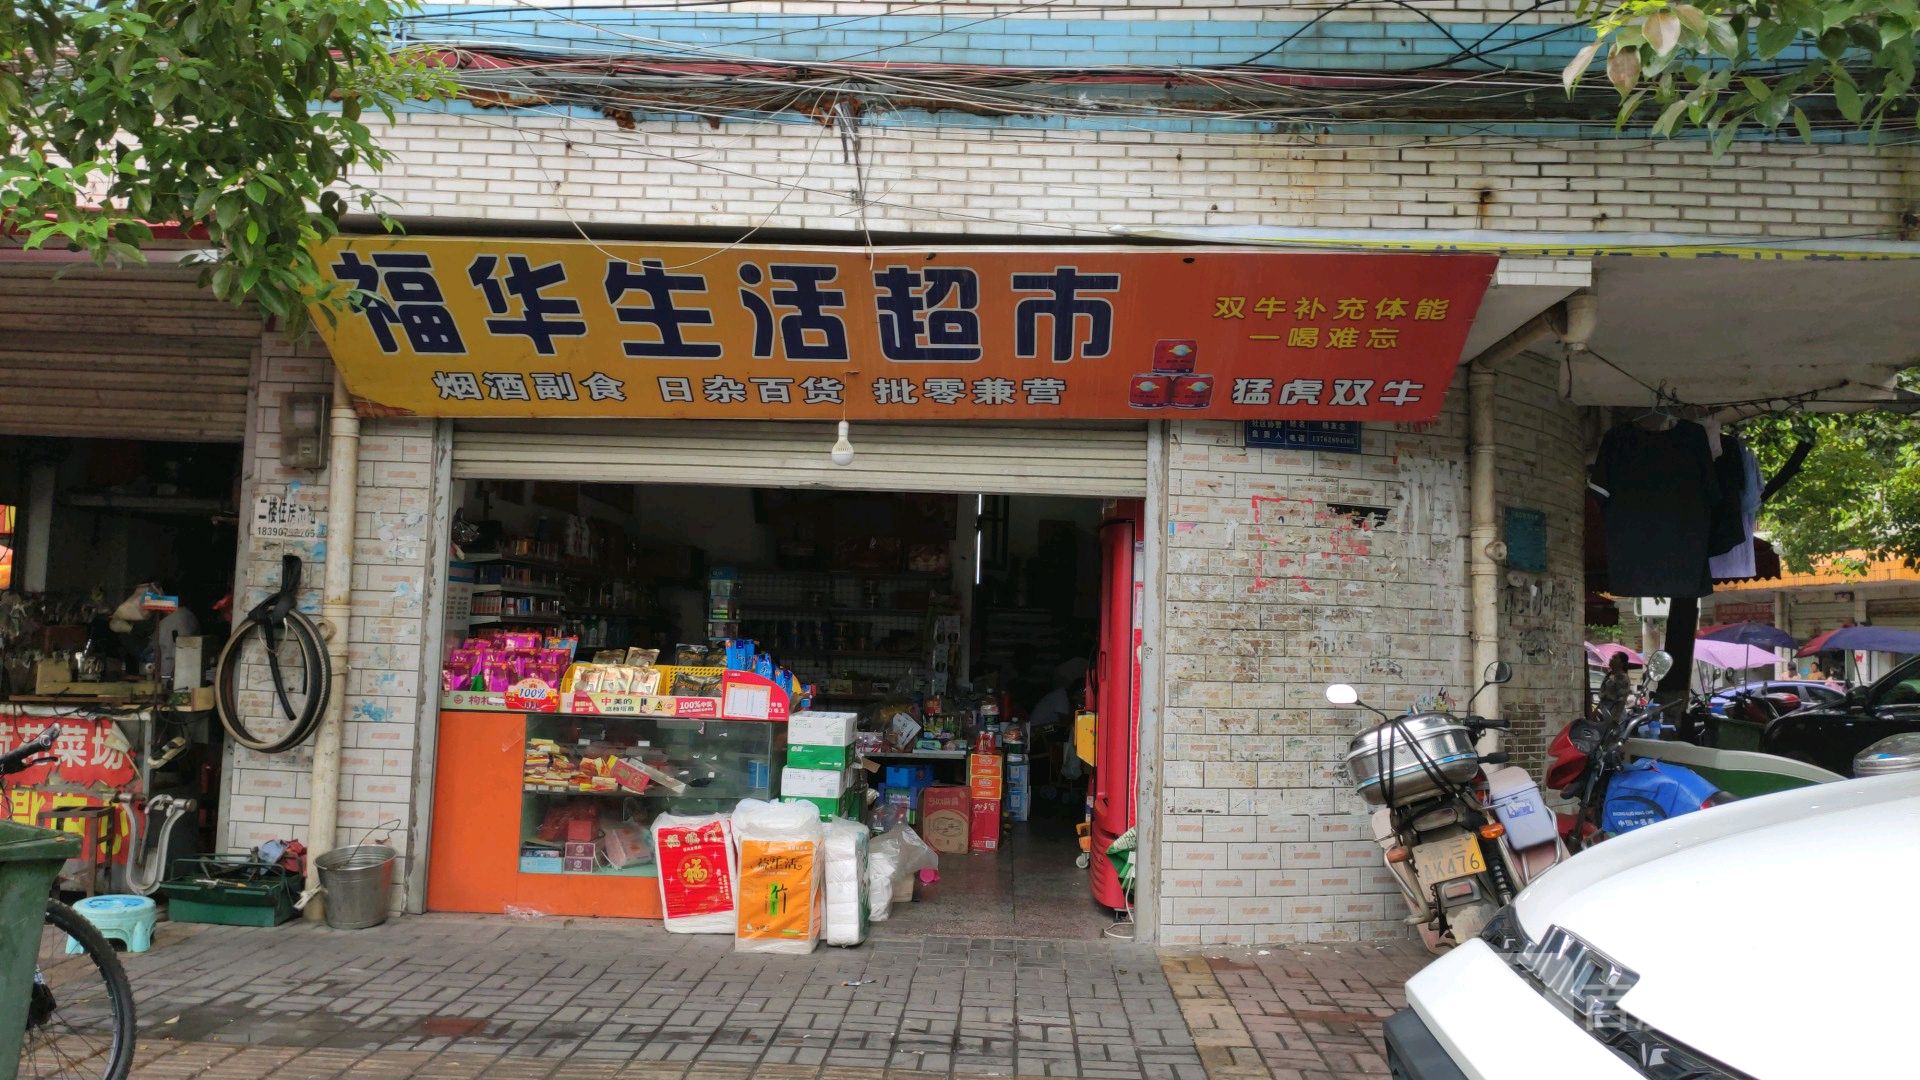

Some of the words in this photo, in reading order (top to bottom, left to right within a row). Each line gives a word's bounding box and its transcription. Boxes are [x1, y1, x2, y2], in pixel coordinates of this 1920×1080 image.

[331, 250, 1121, 364] 福华生活超市
[1213, 296, 1450, 321] 双牛补充体能
[1249, 327, 1400, 349] 一喝难忘
[433, 371, 628, 402] 烟酒副食
[657, 374, 845, 405] 日杂百货
[872, 377, 1067, 405] 批零兼营
[1232, 378, 1424, 407] 猛虎双牛
